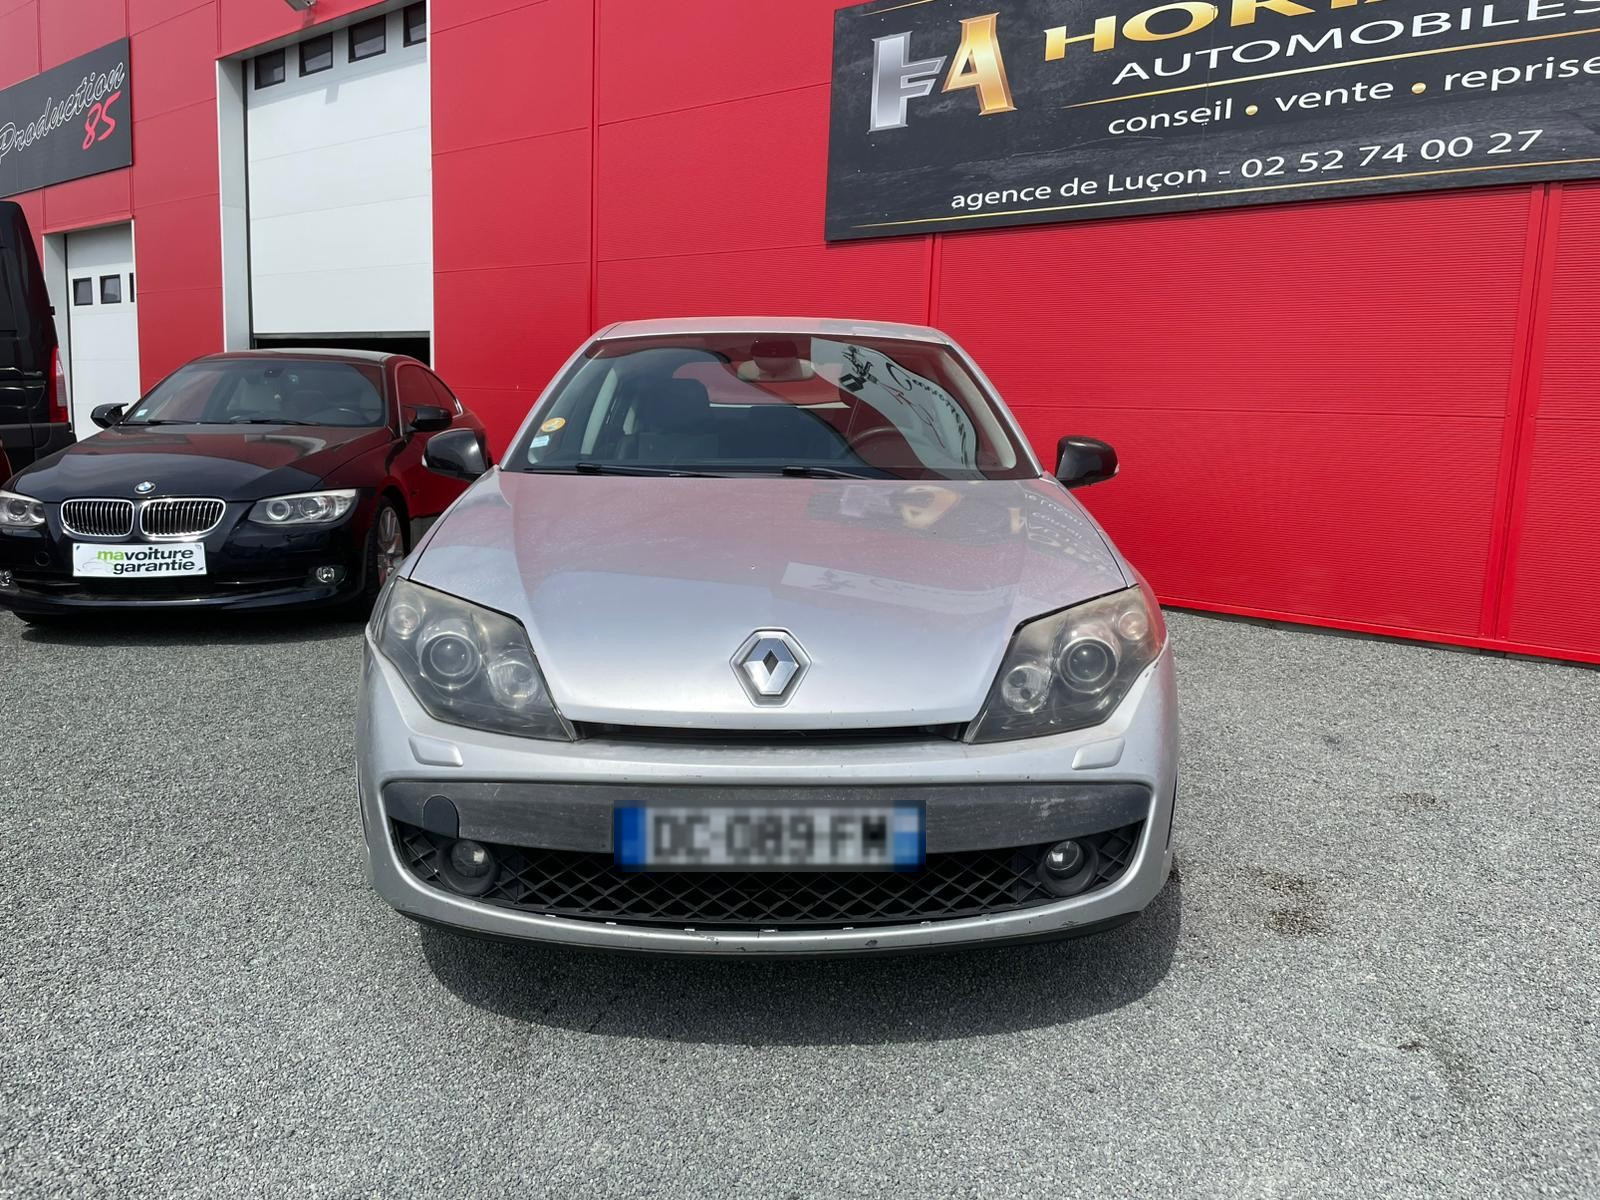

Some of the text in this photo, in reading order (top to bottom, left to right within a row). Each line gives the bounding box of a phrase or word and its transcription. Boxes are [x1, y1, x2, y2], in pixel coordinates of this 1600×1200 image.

[1044, 0, 1385, 62] HOR
[0, 62, 125, 160] Production
[82, 91, 121, 150] 85
[1108, 56, 1600, 134] conseil vente reprise
[951, 186, 1051, 211] agence
[1060, 177, 1098, 197] de
[1107, 168, 1207, 193] Luçon
[1241, 156, 1285, 178] 02
[1297, 150, 1344, 173] 52
[1358, 143, 1408, 166] 74
[1420, 136, 1473, 160] 00
[1486, 129, 1544, 155] 27
[113, 559, 195, 574] garantie
